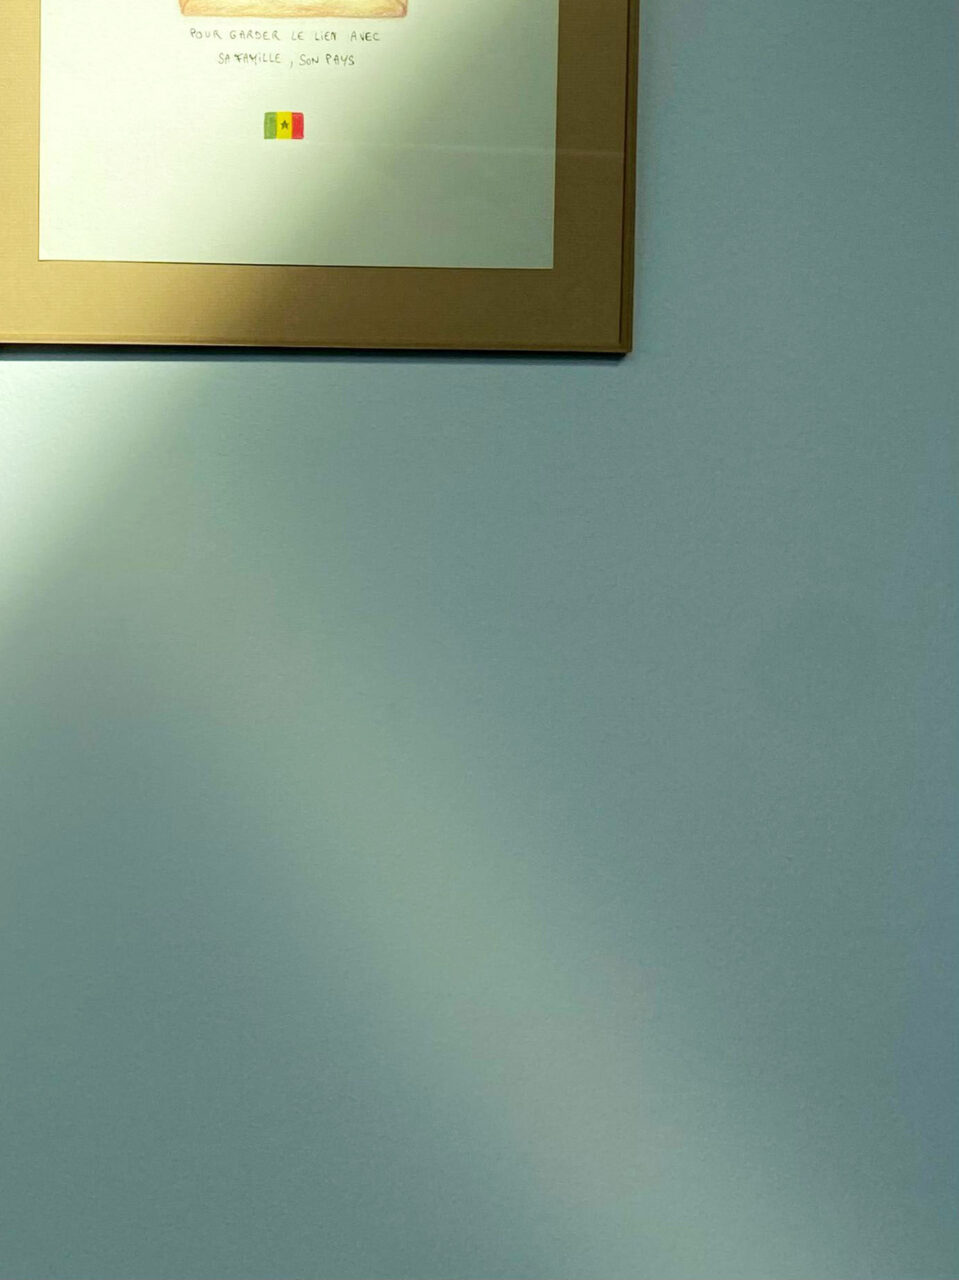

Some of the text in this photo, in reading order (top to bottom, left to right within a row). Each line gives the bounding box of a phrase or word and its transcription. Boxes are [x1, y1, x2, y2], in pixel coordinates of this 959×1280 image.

[190, 27, 222, 41] POUR
[229, 29, 281, 42] GARDER
[291, 31, 304, 42] LE
[349, 31, 381, 42] AVEC
[325, 53, 355, 66] PAYS
